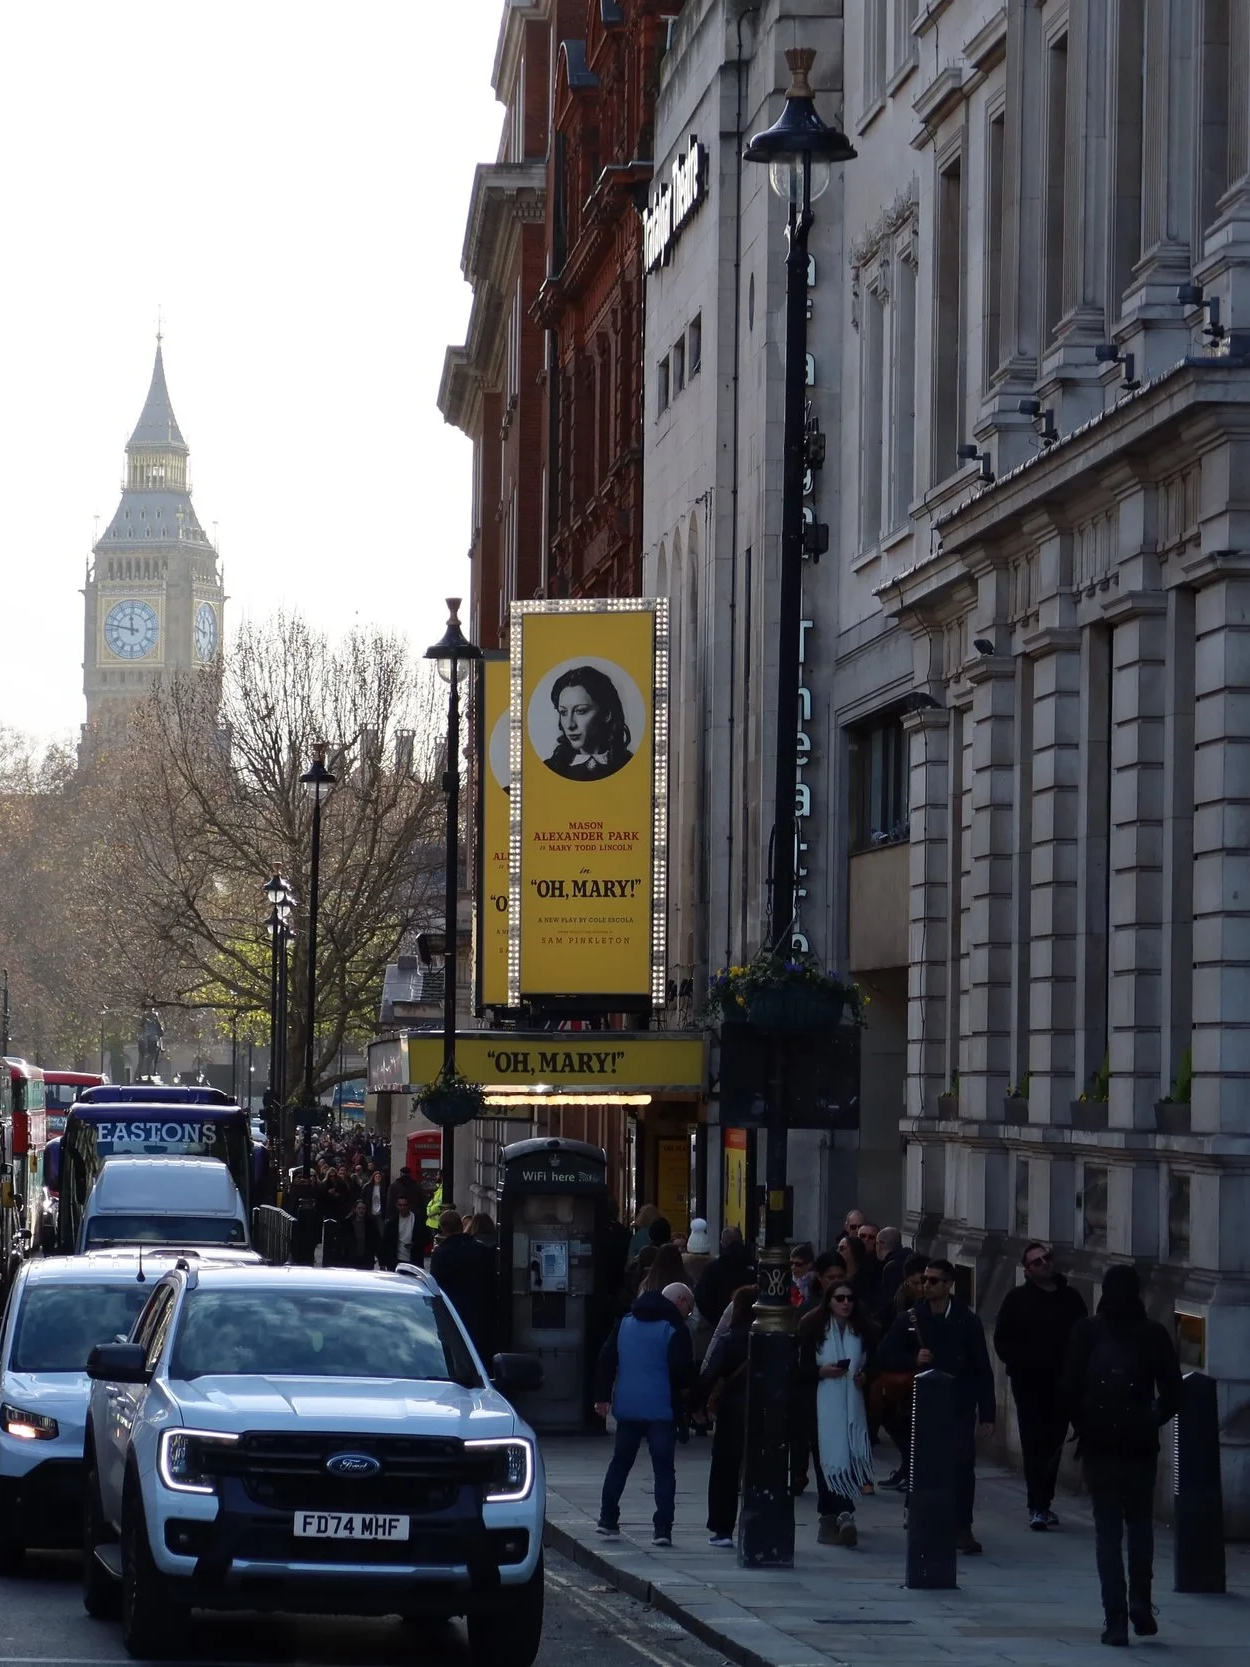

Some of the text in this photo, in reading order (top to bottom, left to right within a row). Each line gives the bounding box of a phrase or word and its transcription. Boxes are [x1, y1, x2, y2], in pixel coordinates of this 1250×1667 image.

[568, 822, 604, 830] MASON
[533, 831, 640, 841] ALEXANDER PARK
[579, 866, 592, 875] in
[96, 1121, 217, 1145] EASTONS
[522, 1171, 576, 1182] WiFi here
[339, 1458, 368, 1471] Ford
[302, 1514, 400, 1537] FD74 MHF
